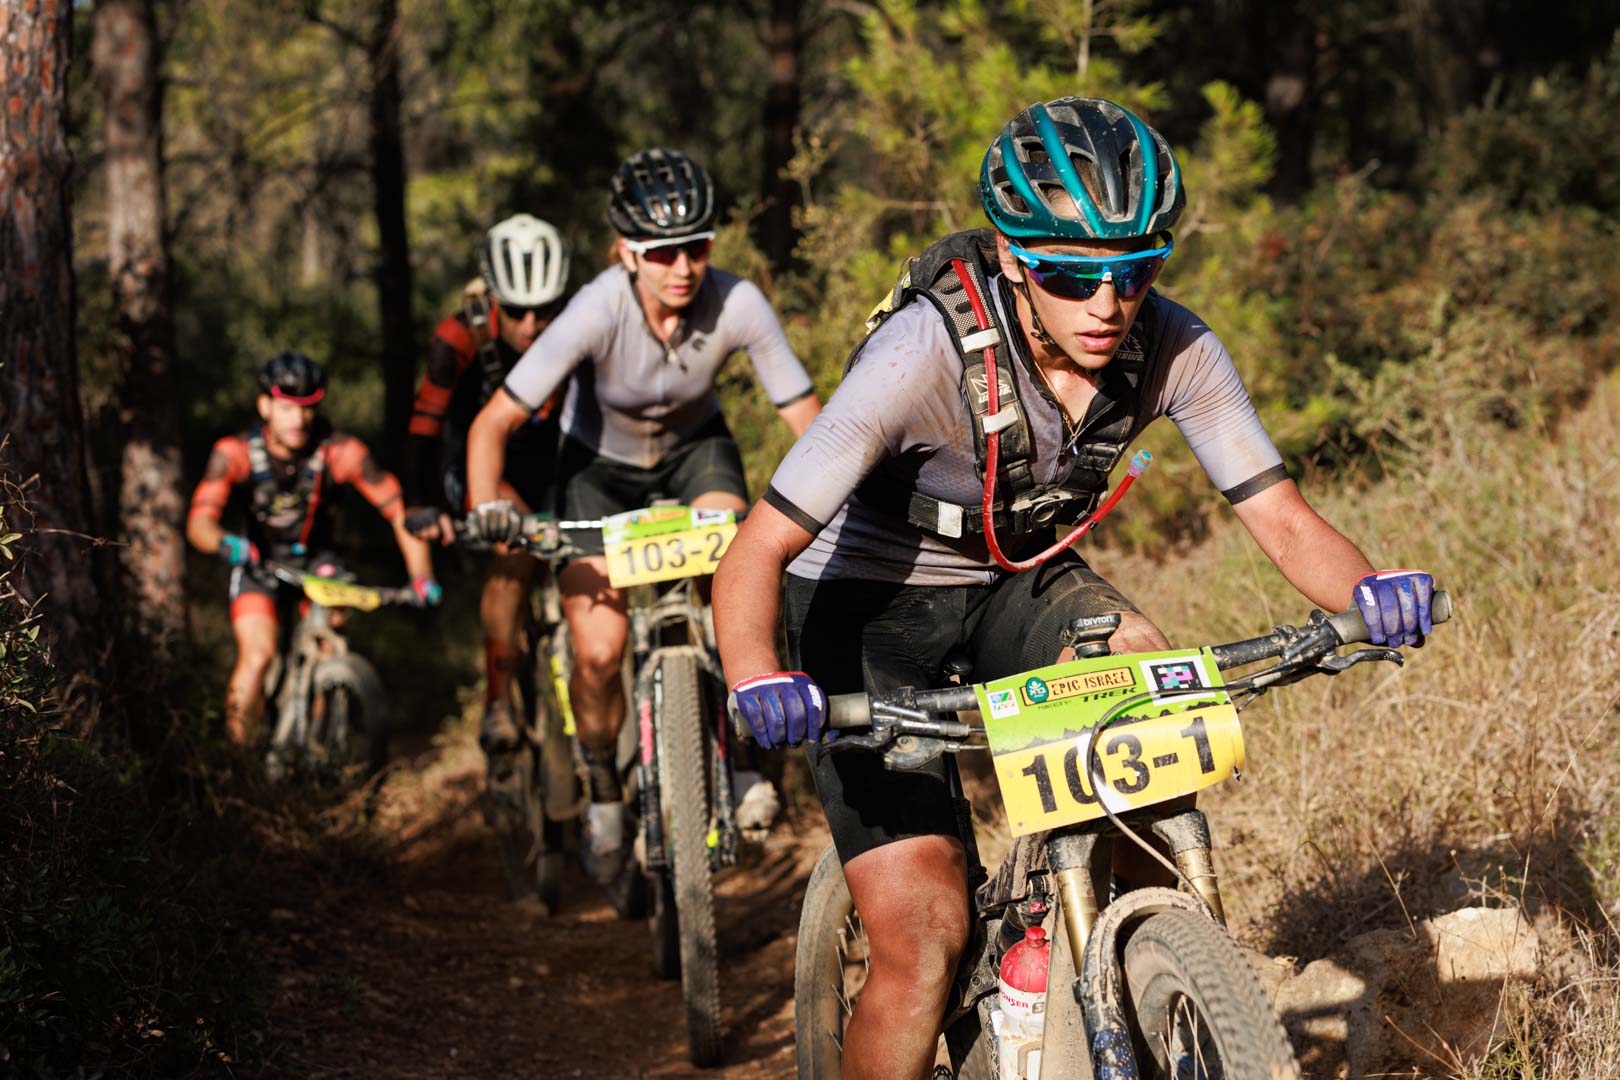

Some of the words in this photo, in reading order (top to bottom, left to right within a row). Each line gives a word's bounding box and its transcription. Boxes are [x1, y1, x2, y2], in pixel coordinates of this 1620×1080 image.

[621, 532, 724, 575] 103-2
[1051, 679, 1081, 696] EPIC
[1084, 671, 1129, 689] ISRAEL
[1081, 687, 1136, 702] TREK
[1022, 716, 1215, 814] 103-1
